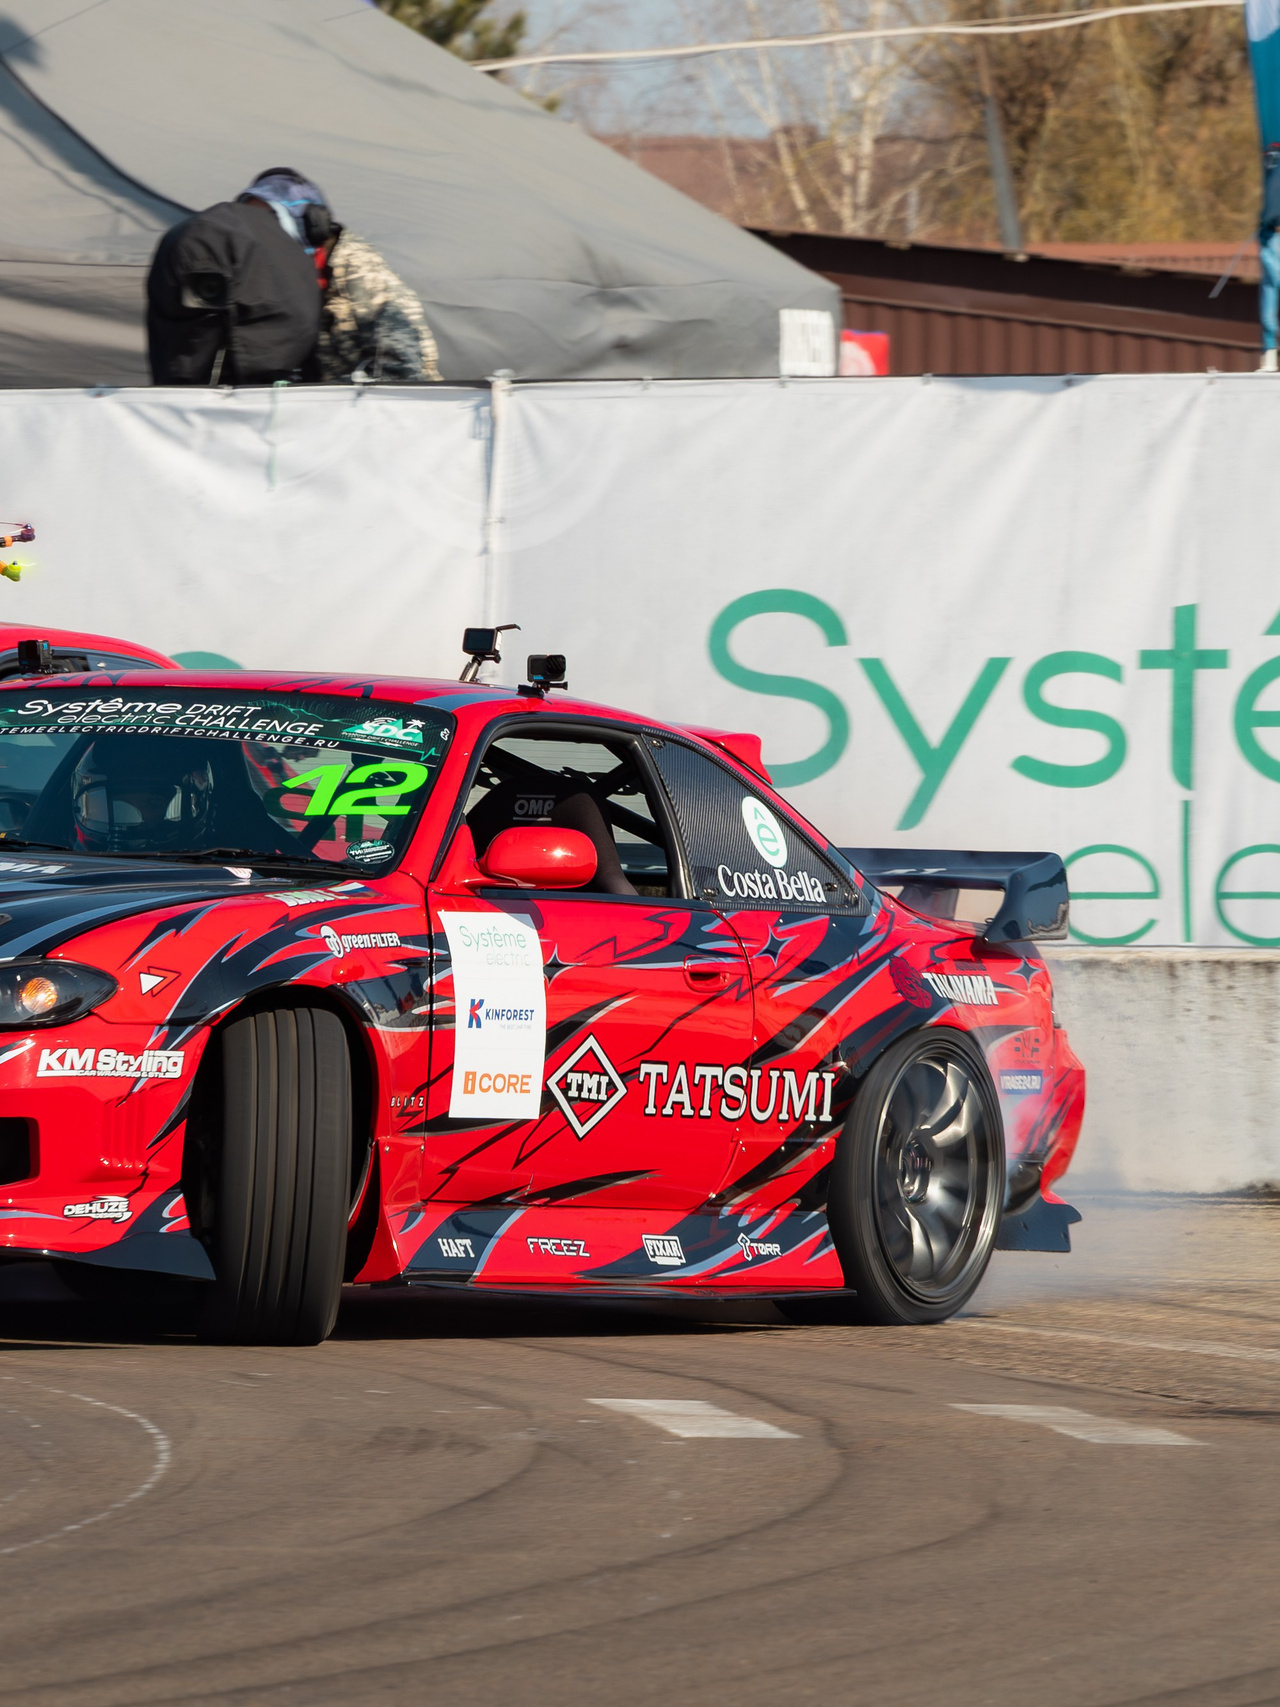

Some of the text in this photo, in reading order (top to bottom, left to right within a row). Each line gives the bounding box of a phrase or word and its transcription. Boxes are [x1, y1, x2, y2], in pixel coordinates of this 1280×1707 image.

[184, 703, 262, 718] DRIFT
[57, 711, 324, 736] electric CHALLENGE
[360, 721, 421, 741] SDC
[281, 763, 428, 815] 12
[514, 799, 554, 815] OMP
[717, 864, 827, 903] Costa Bella
[340, 932, 401, 953] green FILTER
[921, 972, 999, 1006] TAKAYAMA
[485, 1008, 535, 1021] KINFOREST
[39, 1048, 185, 1075] KM Styling
[567, 1072, 609, 1101] TMI
[639, 1062, 836, 1122] TATSUMI
[390, 1096, 424, 1107] BLITZ
[63, 1200, 129, 1215] DEHUZE
[438, 1238, 475, 1258] HAFT
[645, 1239, 681, 1257] FIXAR
